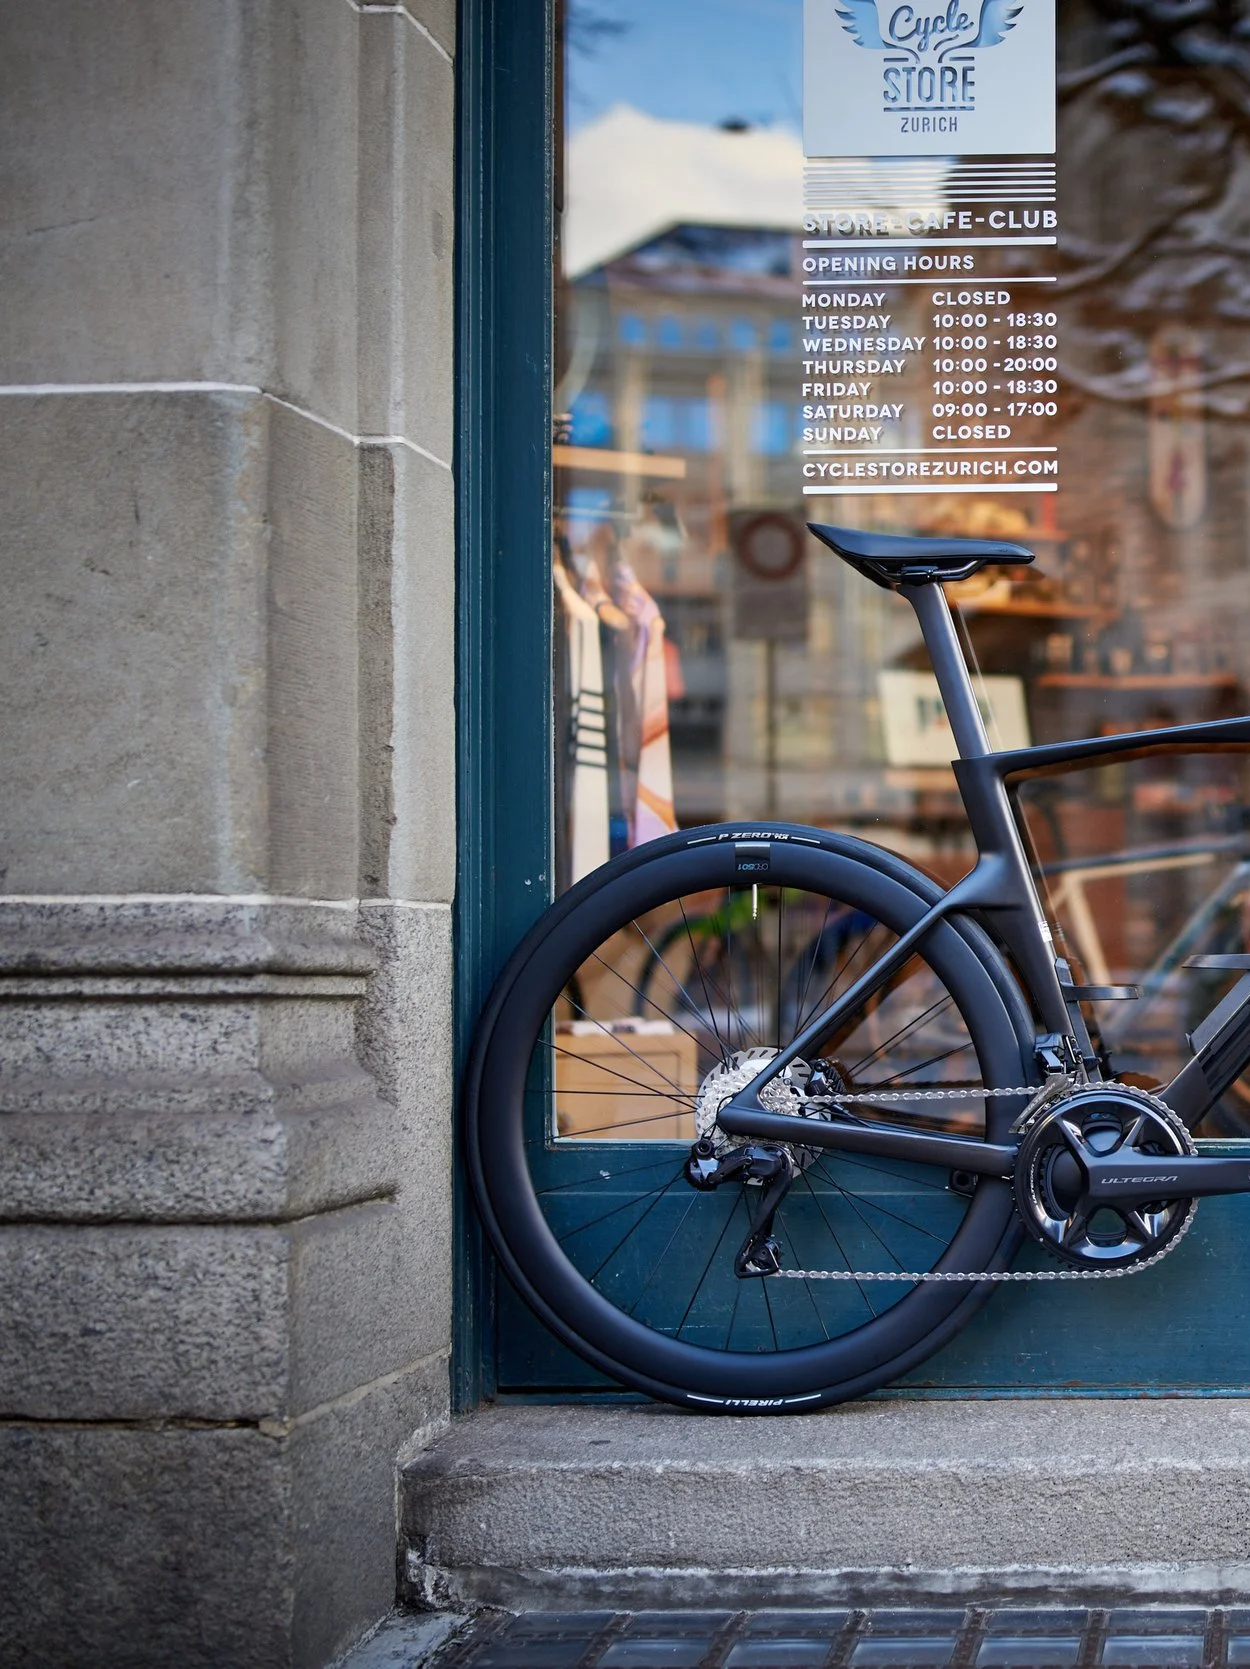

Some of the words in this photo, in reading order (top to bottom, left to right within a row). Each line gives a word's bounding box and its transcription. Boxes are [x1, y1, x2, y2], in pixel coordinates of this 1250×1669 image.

[889, 0, 975, 51] Cycle
[883, 66, 975, 103] STORE
[900, 116, 958, 133] ZURICH
[802, 257, 896, 272] OPENING
[903, 255, 974, 271] HOURS
[802, 293, 886, 308] MONDAY
[932, 291, 1011, 306] CLOSED
[802, 315, 891, 330] TUESDAY
[932, 313, 987, 328] 10:00
[1006, 312, 1057, 327] 18:30
[803, 337, 926, 352] WEDNESDAY
[932, 336, 987, 350] 10:00
[1006, 335, 1057, 349] 18:30
[803, 359, 906, 374] THURSDAY
[932, 358, 987, 372] 10:00
[1003, 357, 1057, 371] 20:00
[802, 382, 872, 397] FRIDAY
[932, 380, 987, 395] 10:00
[1006, 379, 1057, 394] 18:30
[803, 404, 904, 419] SATURDAY
[932, 403, 988, 417] 09:00
[1007, 402, 1058, 416] 17:00
[803, 426, 883, 441] SUNDAY
[932, 425, 1011, 440] CLOSED
[802, 460, 1058, 478] CYCLESTOREZURICH.COM
[1101, 1174, 1178, 1185] ULTEGRA
[725, 1398, 785, 1407] PIRELLI
